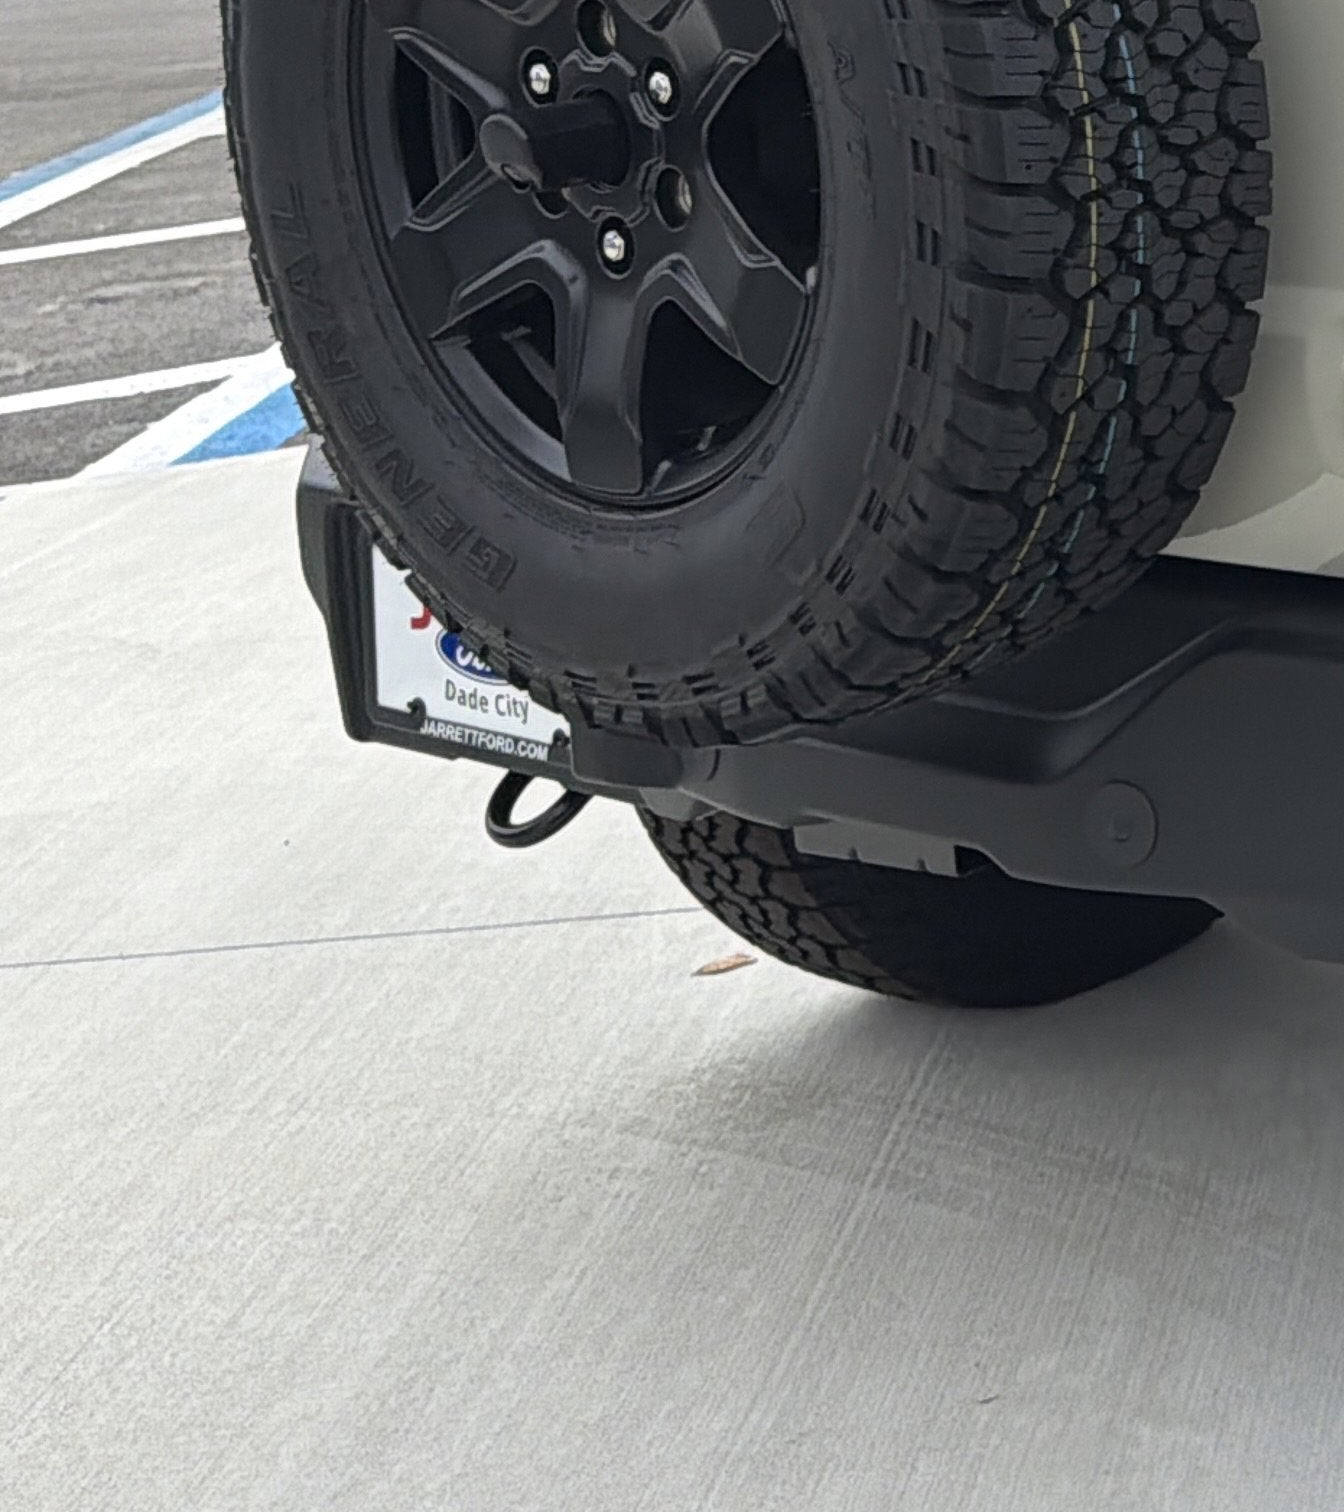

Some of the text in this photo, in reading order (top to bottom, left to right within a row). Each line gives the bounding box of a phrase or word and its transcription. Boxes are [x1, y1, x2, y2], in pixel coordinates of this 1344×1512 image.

[269, 186, 516, 591] GENERAL
[445, 678, 530, 724] Dade City
[420, 719, 548, 761] JARRETTFORD.COM
